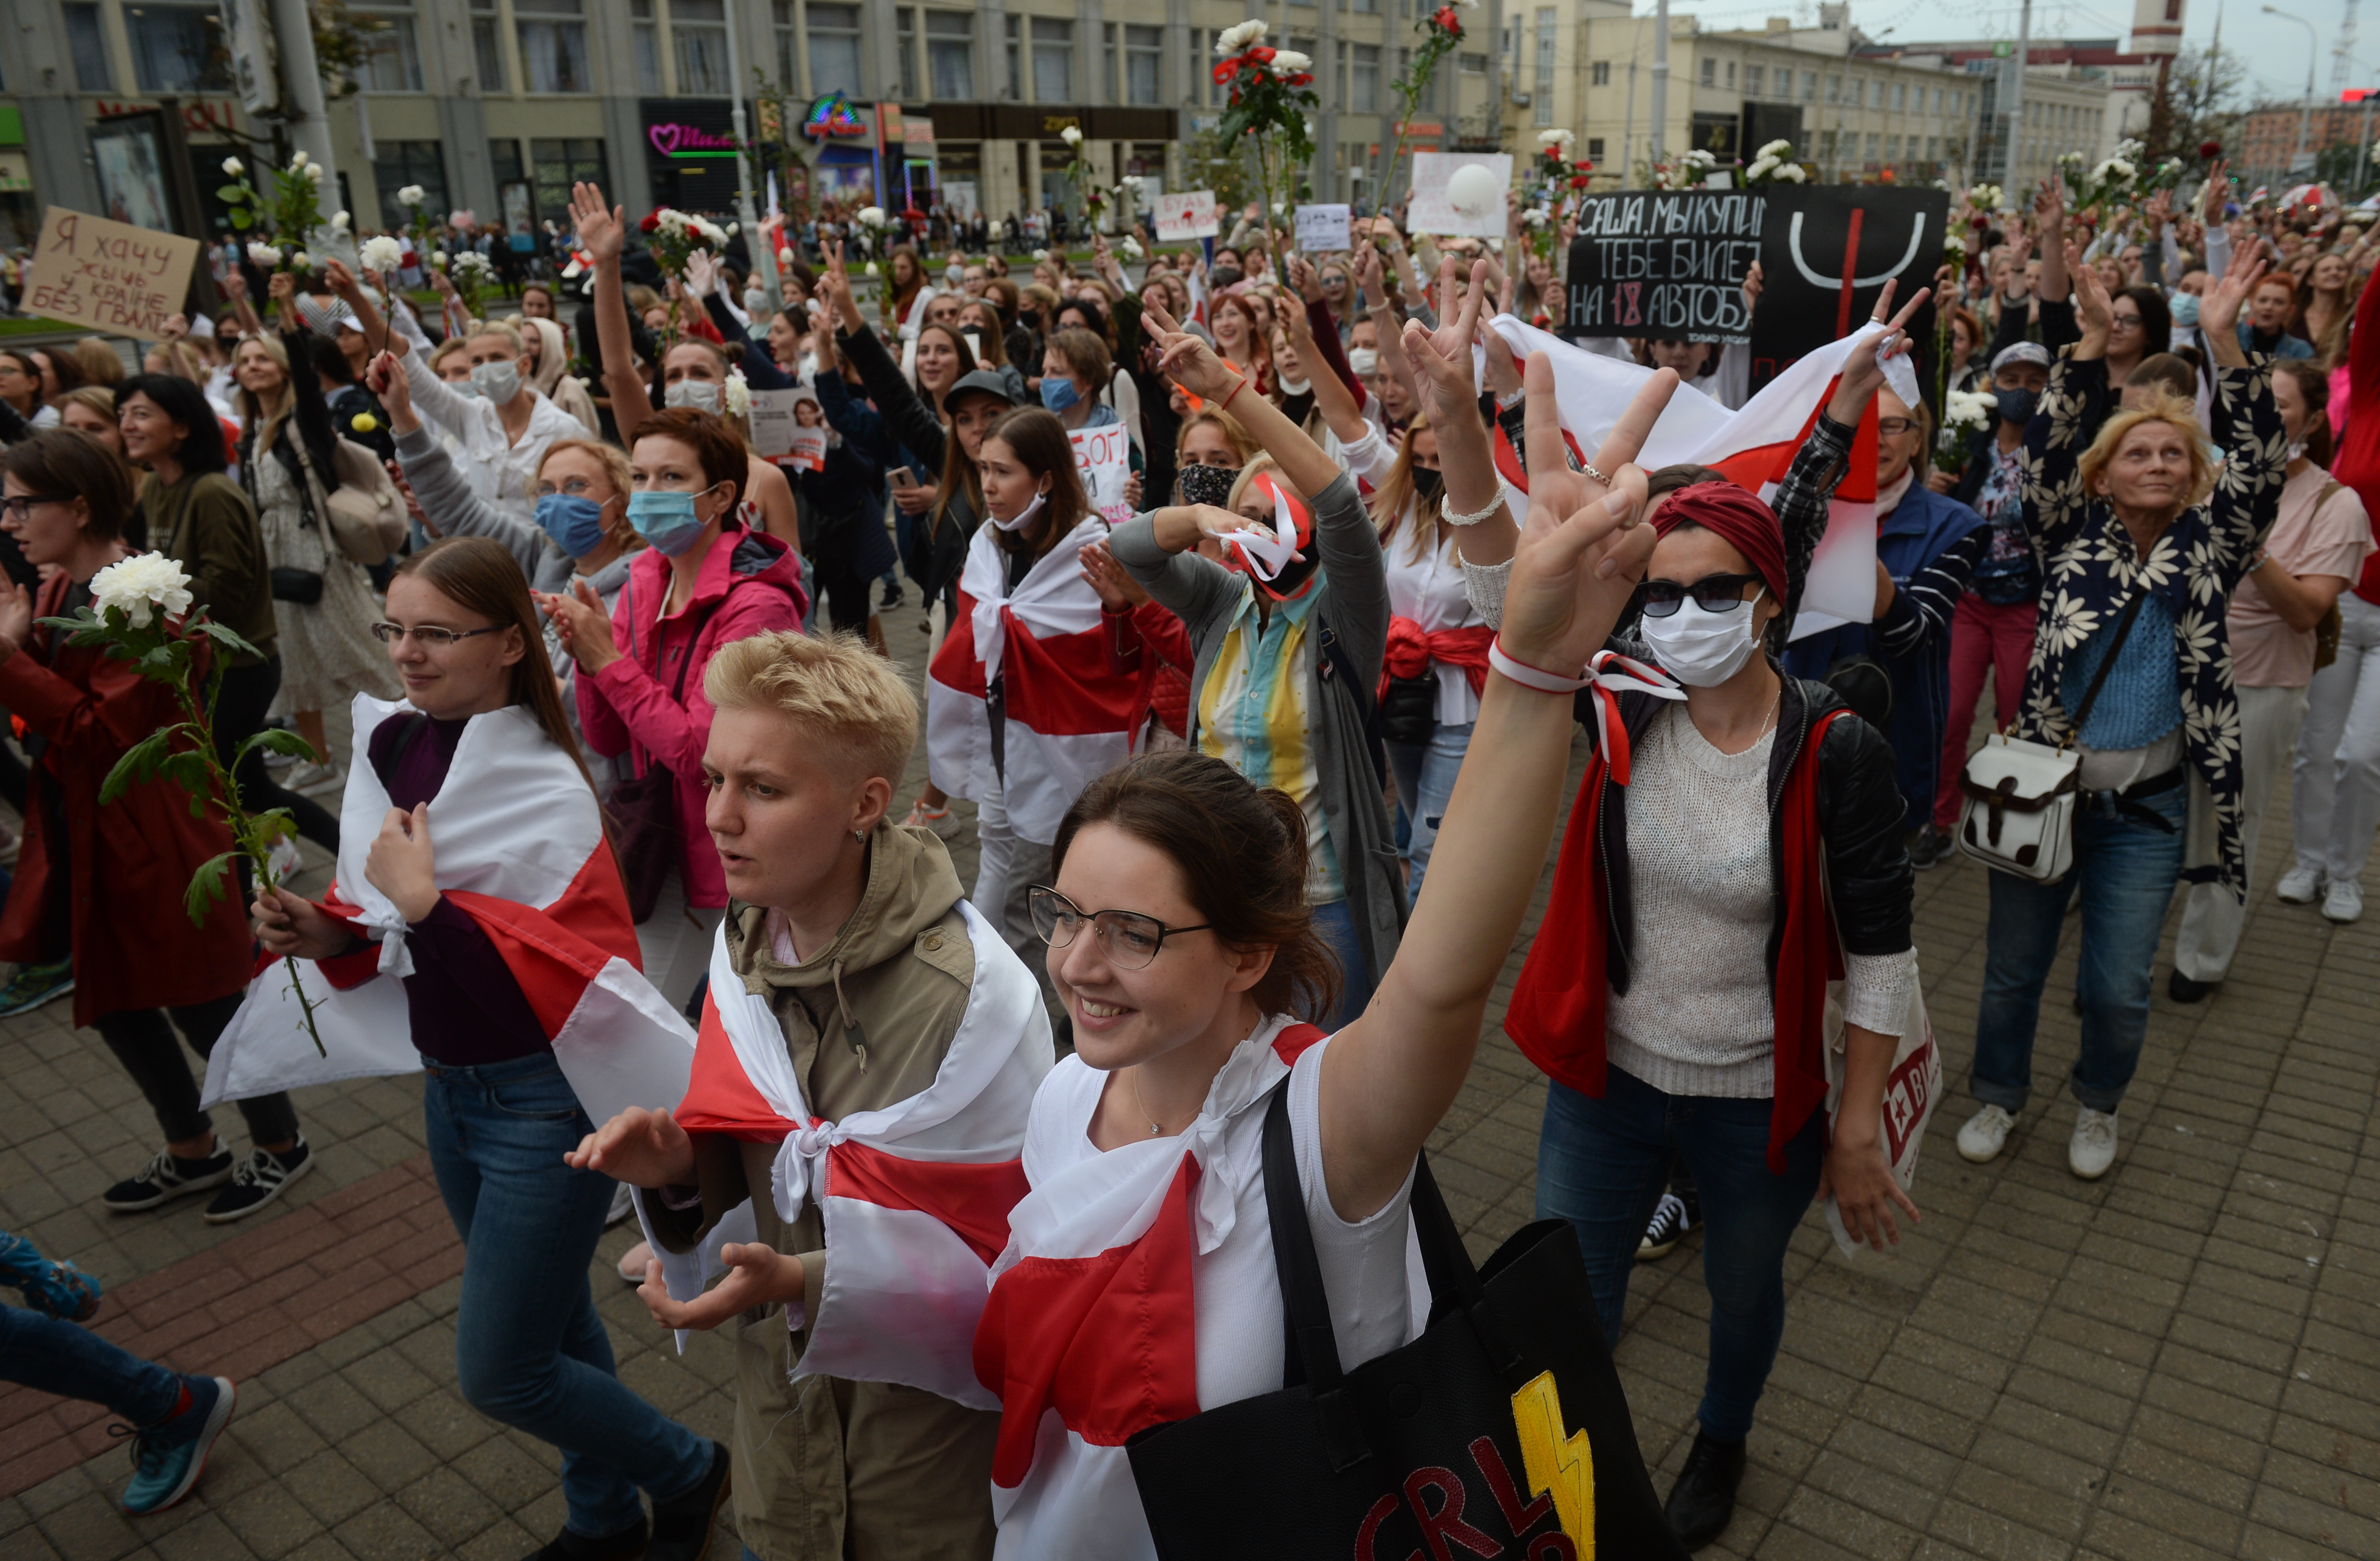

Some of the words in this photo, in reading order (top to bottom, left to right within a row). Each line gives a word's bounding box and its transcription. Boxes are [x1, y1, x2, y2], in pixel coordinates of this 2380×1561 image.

[50, 215, 79, 255] Я
[1650, 195, 1694, 235] МЫ
[1593, 238, 1665, 280] ТЕБЕ
[32, 285, 83, 316] БЕЗ
[1570, 284, 1604, 327] НА
[1610, 281, 1643, 326] 18
[1647, 283, 1752, 332] АВТОБУ
